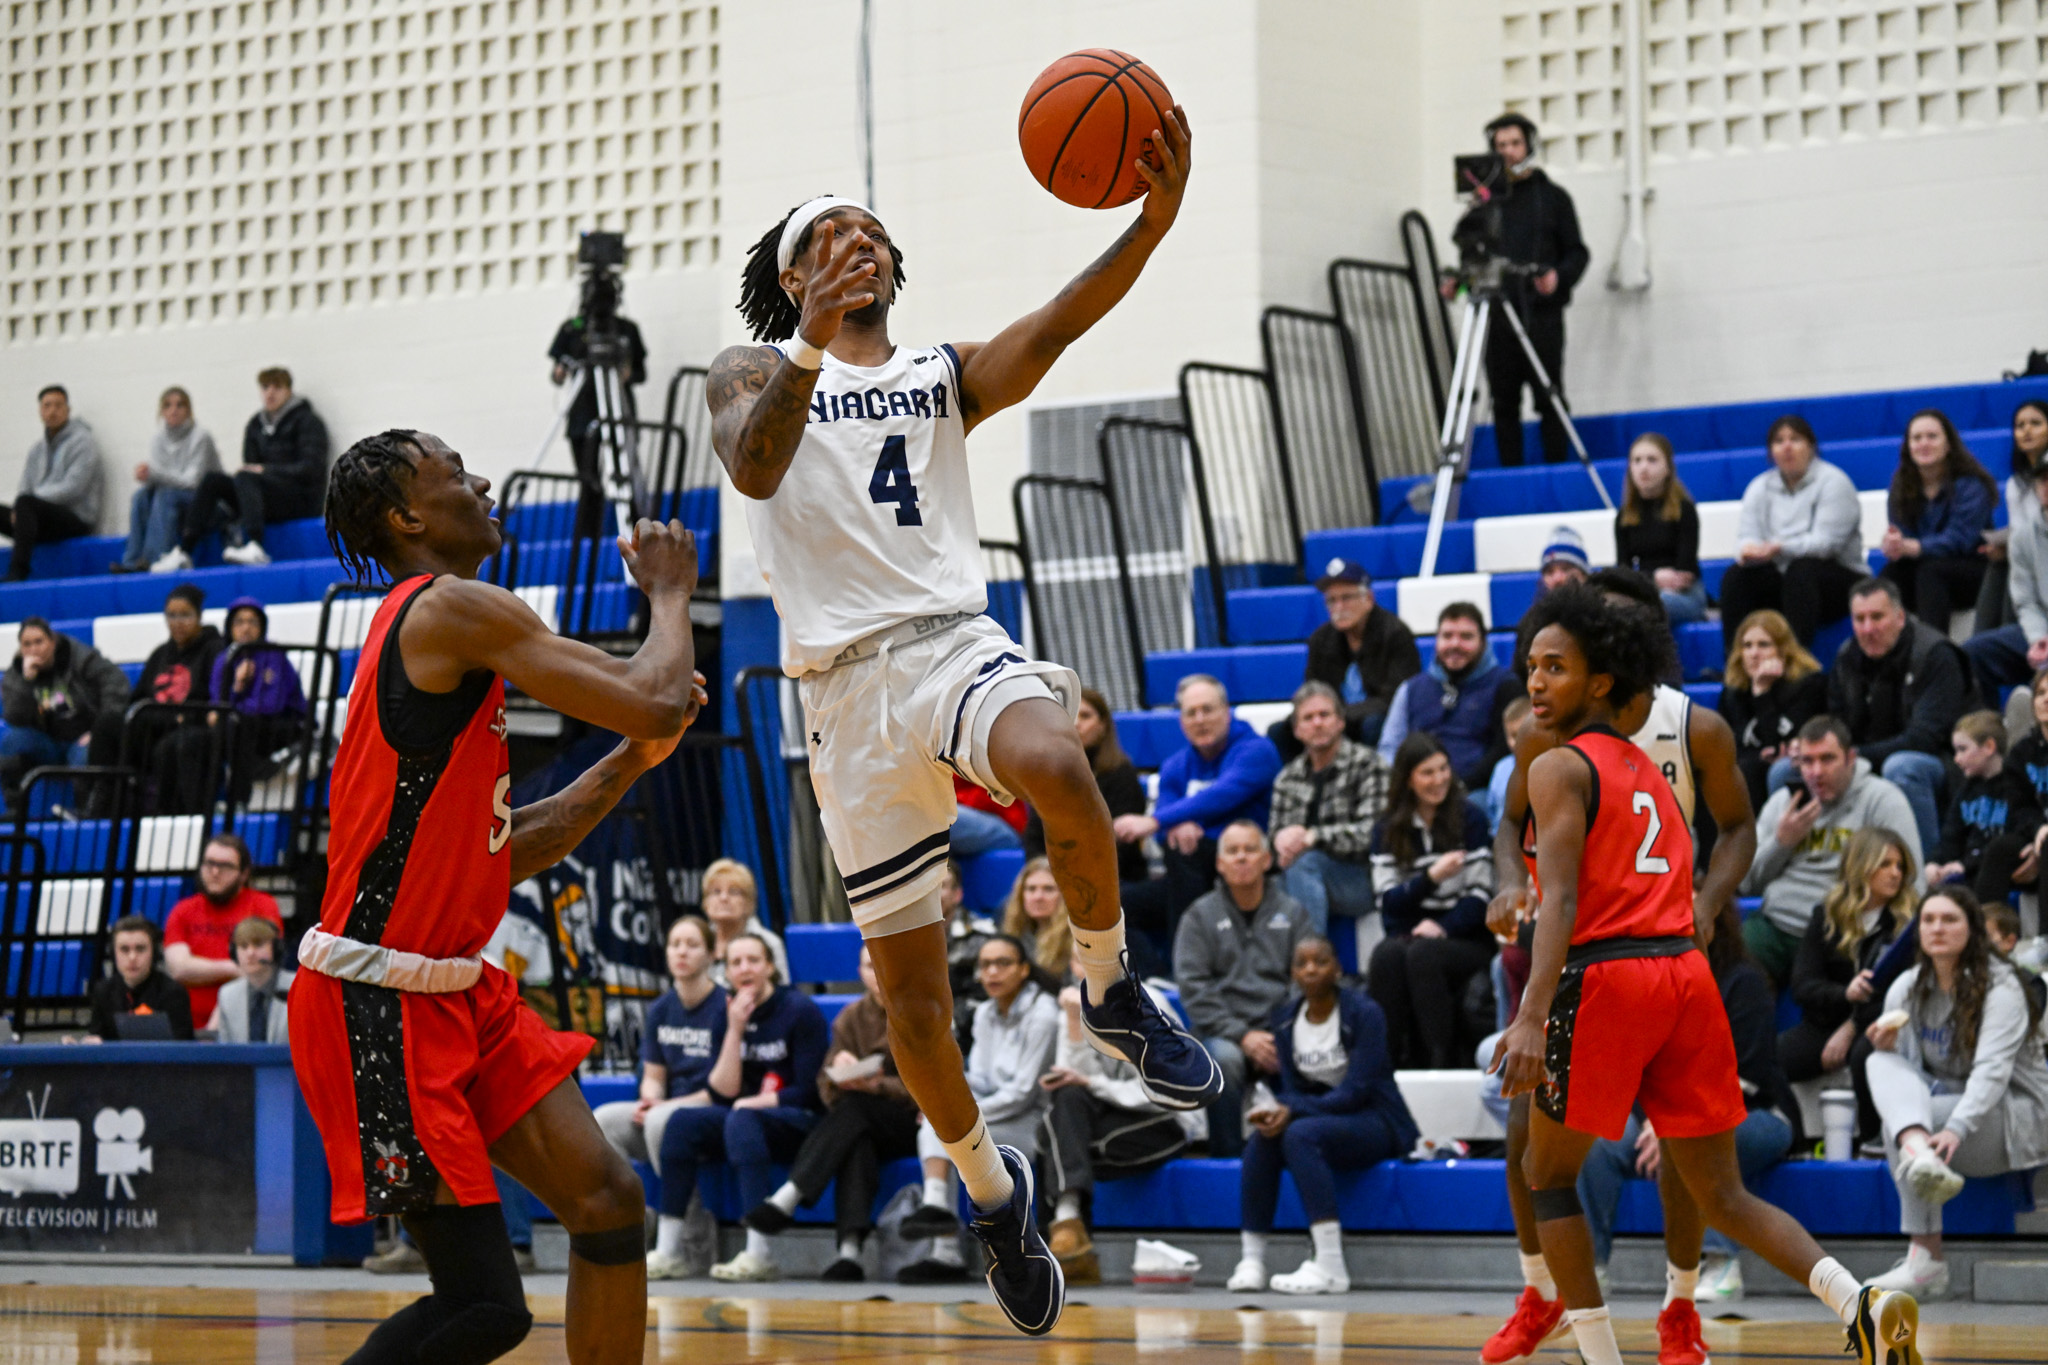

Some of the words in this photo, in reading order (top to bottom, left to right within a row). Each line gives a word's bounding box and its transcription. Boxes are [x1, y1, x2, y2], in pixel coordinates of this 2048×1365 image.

[806, 381, 949, 423] NIAGARA
[868, 434, 923, 527] 4
[1632, 790, 1671, 874] 2
[0, 1141, 72, 1168] BRTF
[115, 1208, 158, 1228] FILM
